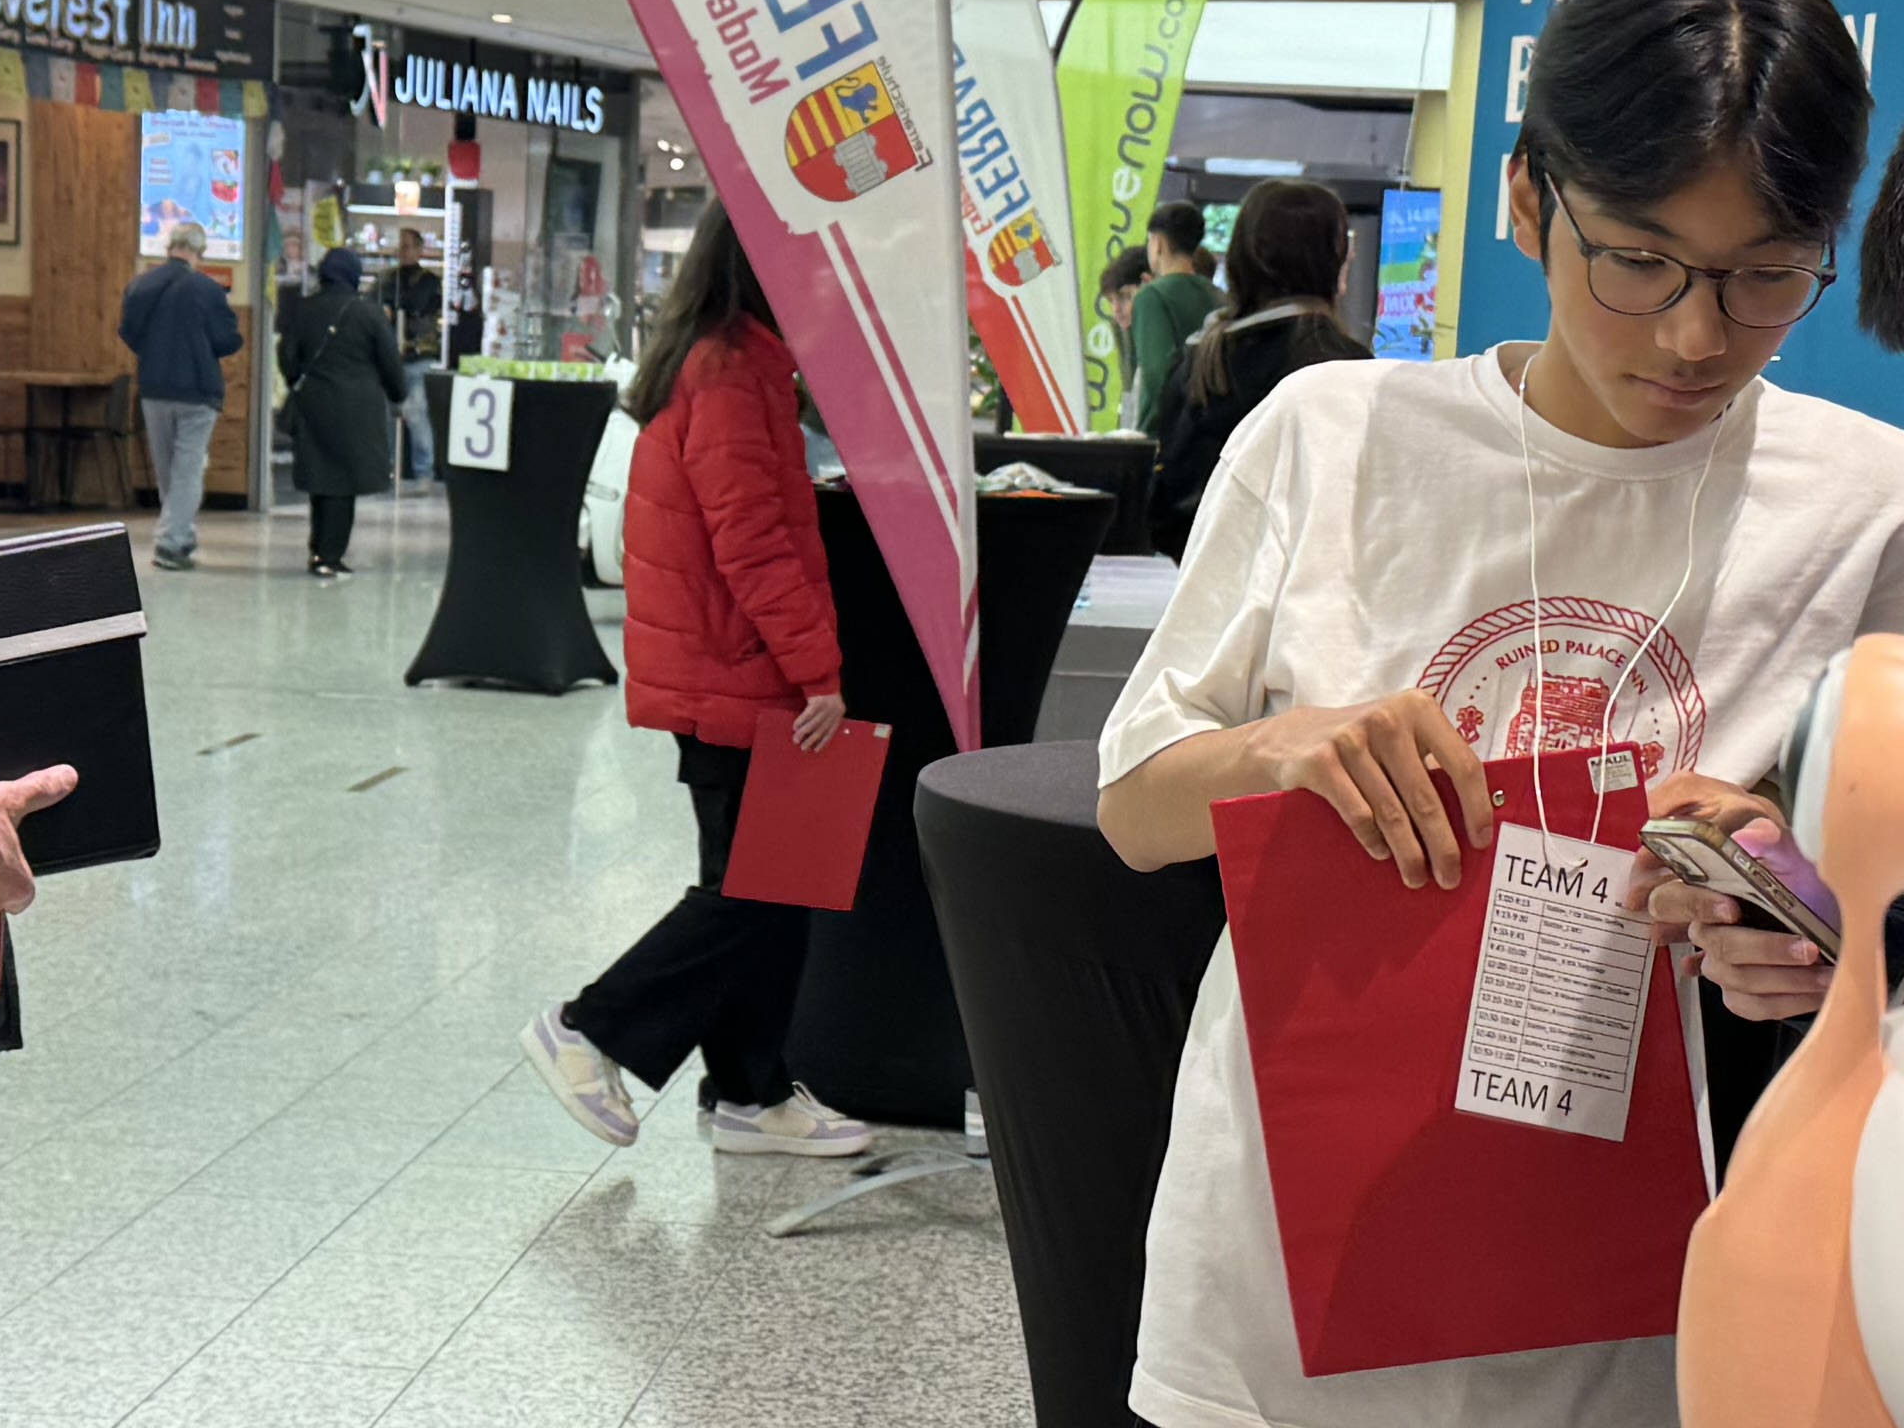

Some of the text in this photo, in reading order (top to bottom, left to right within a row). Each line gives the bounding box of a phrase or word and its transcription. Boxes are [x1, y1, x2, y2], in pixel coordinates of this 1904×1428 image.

[395, 53, 605, 134] JULIANA NAILS
[464, 387, 497, 460] 3
[1496, 639, 1559, 670] RUINED
[1566, 640, 1627, 668] PALACE
[1505, 853, 1609, 904] TEAM 4
[1470, 1069, 1573, 1117] TEAM 4
